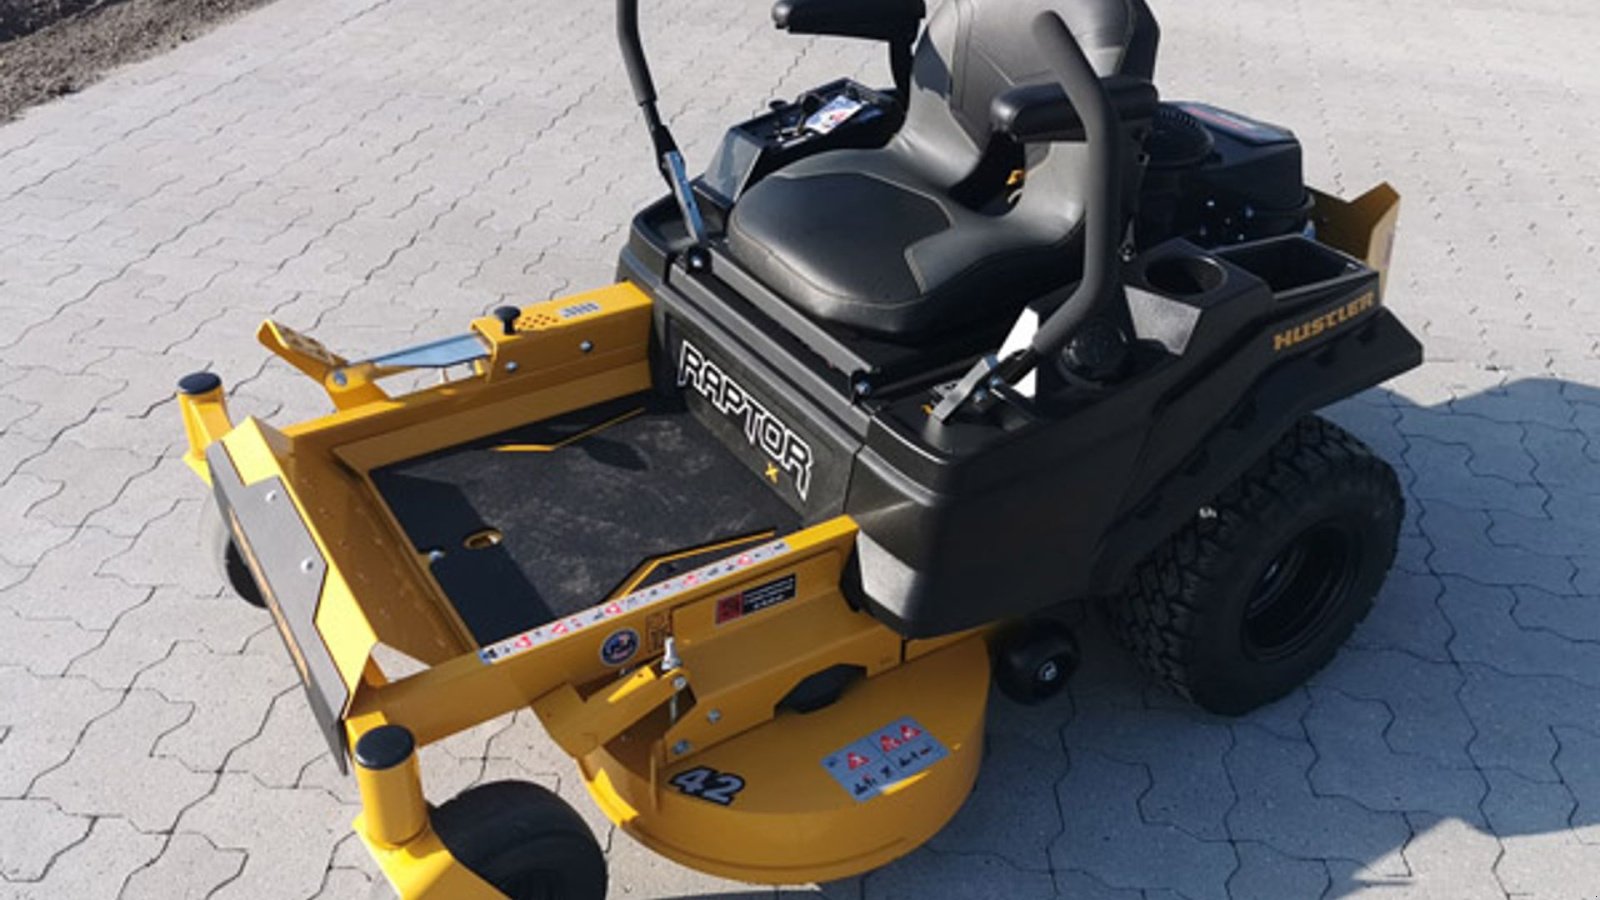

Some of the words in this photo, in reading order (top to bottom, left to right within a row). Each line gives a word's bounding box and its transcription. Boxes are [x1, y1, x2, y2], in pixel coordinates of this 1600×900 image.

[1273, 291, 1375, 351] HUSTLER
[677, 339, 814, 501] RAPTOR
[669, 767, 745, 806] 42
